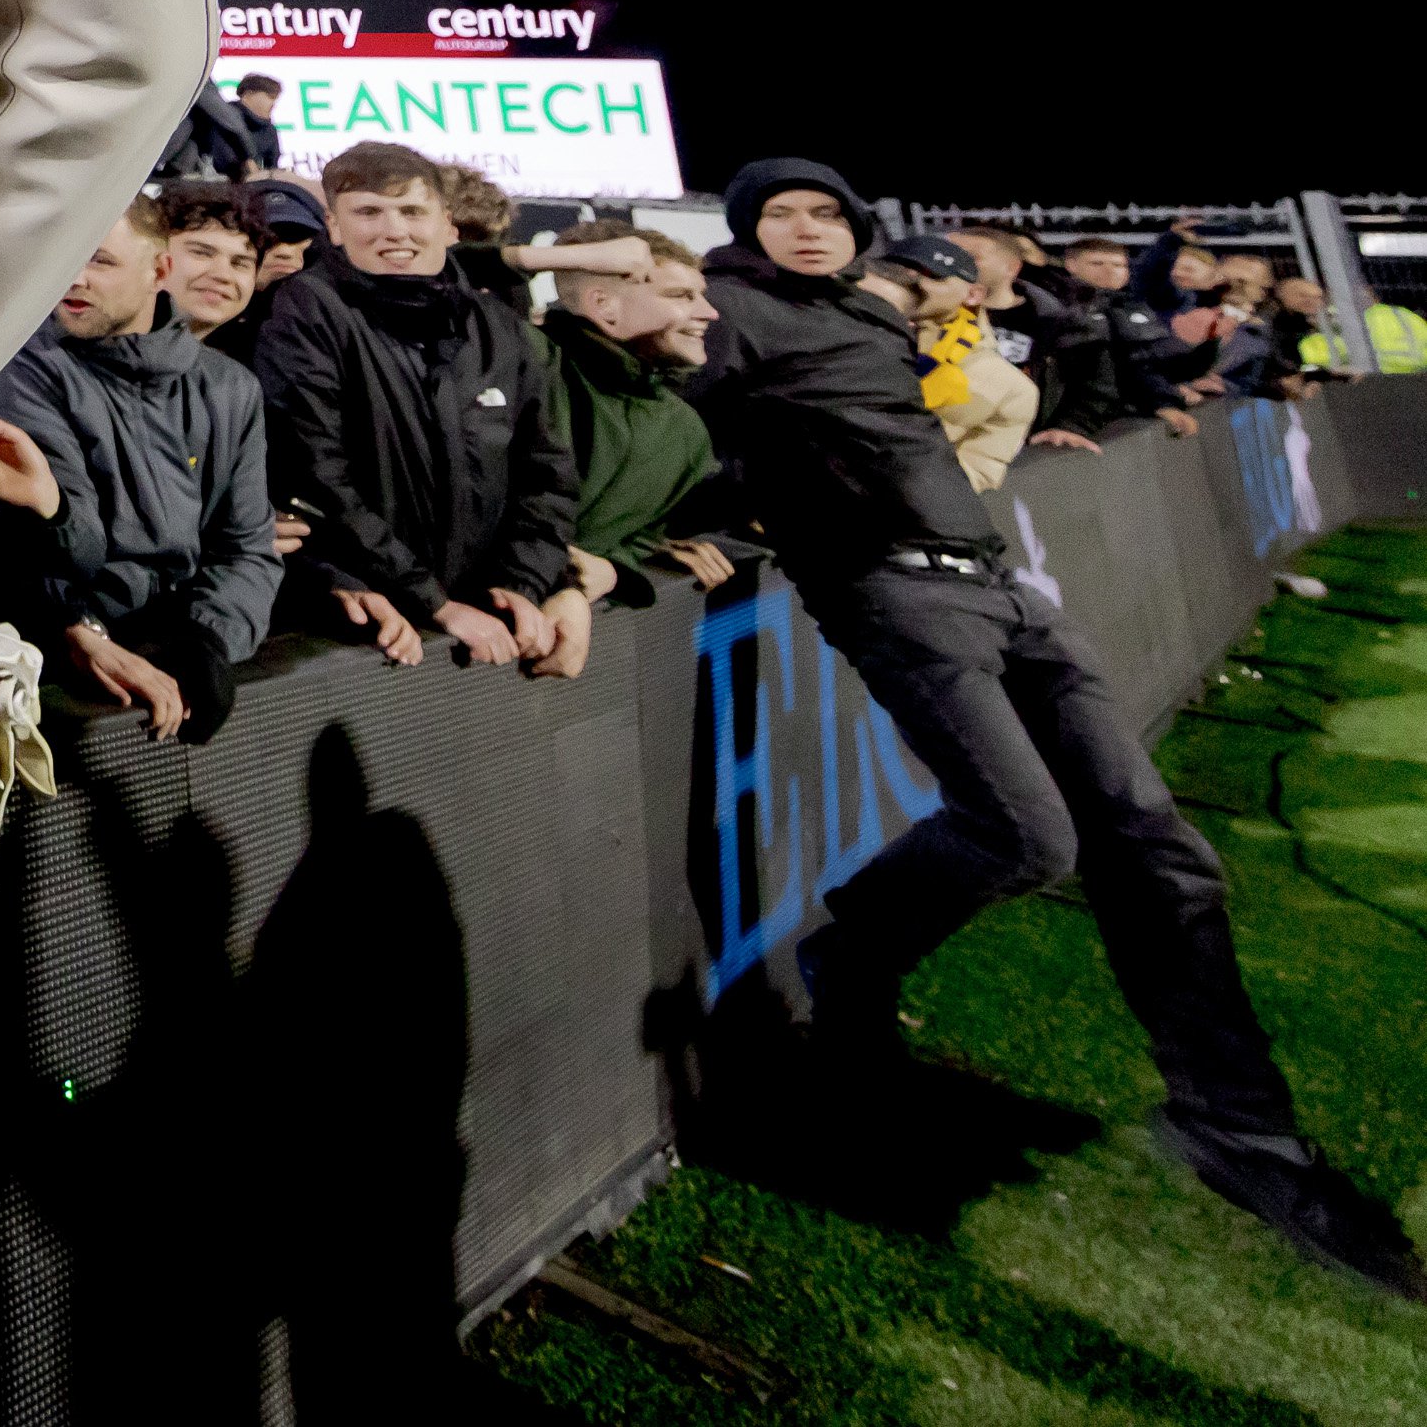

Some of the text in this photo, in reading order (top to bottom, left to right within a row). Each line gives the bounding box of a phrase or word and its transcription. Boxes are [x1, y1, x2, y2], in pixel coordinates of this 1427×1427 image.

[218, 2, 362, 49] entury
[427, 3, 596, 50] century
[216, 79, 649, 135] EANTECH
